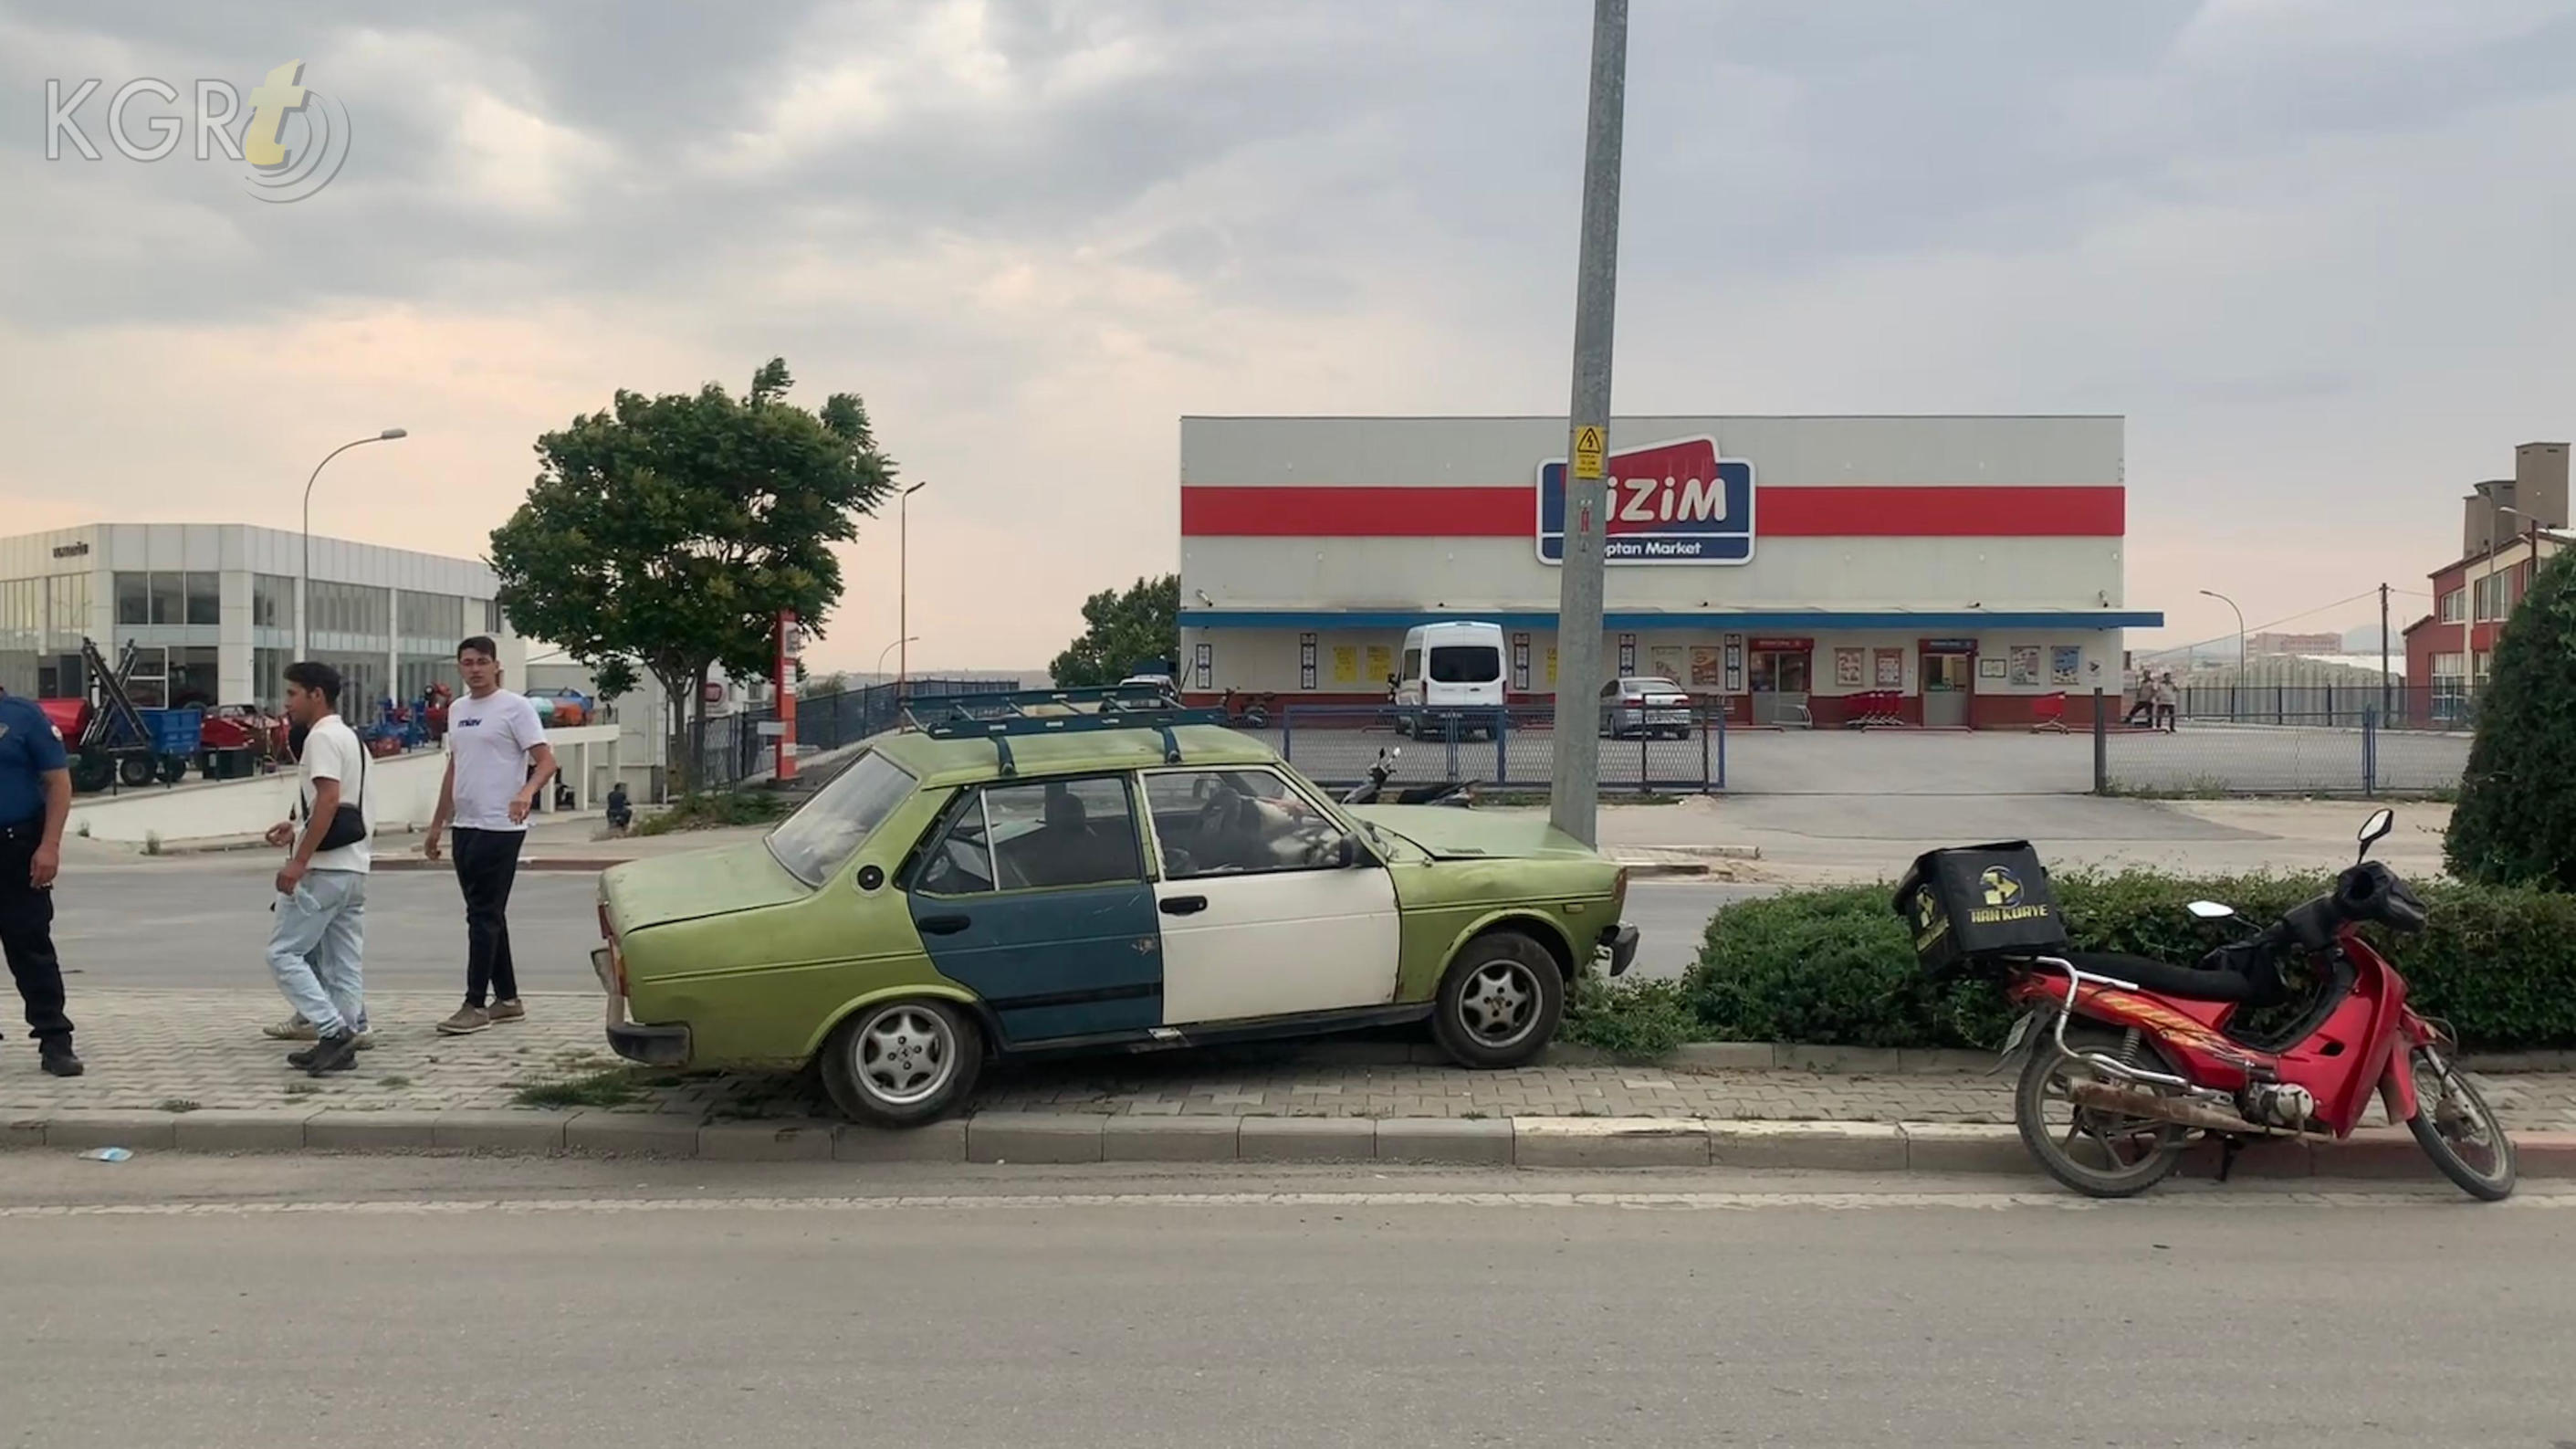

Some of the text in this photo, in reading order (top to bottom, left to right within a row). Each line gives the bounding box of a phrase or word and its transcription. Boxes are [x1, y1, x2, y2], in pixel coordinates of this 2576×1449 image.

[1605, 476, 1727, 521] iZiM
[1604, 541, 1702, 555] ptan Market
